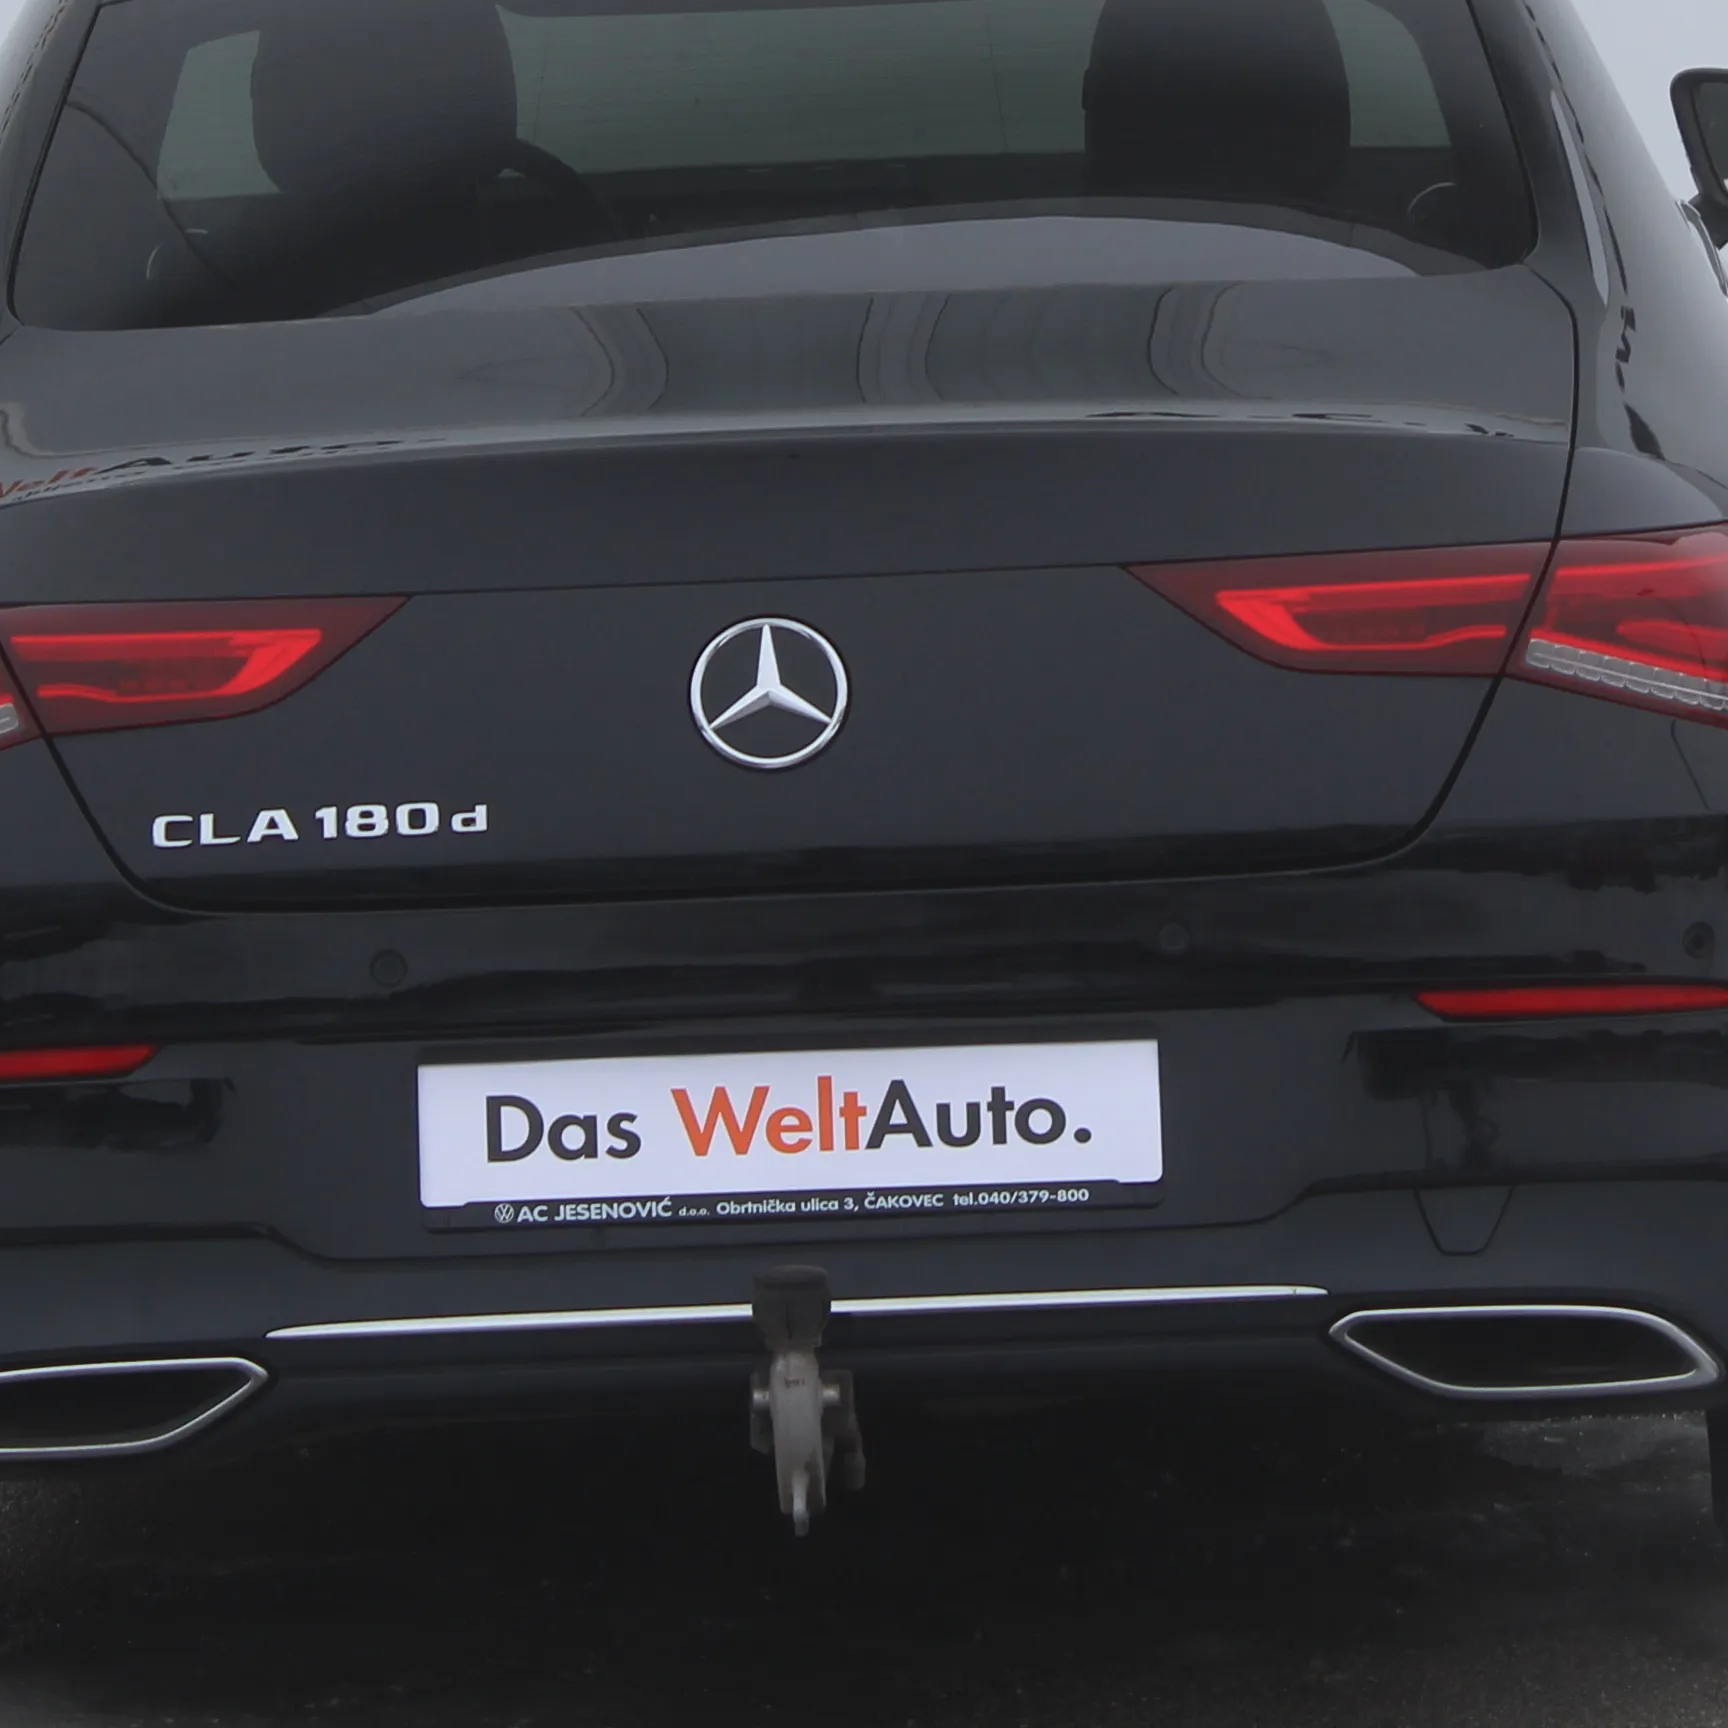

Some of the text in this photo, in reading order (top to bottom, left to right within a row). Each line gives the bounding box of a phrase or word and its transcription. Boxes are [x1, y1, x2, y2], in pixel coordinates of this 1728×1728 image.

[152, 809, 299, 848] CLA
[485, 1075, 1092, 1164] Das WeltAuto.
[516, 1205, 549, 1224] AC
[554, 1196, 674, 1223] JESENOVIĆ
[678, 1205, 711, 1218] d.o.o.
[715, 1197, 797, 1216] Obrtnička
[800, 1196, 840, 1214] ulica
[843, 1196, 860, 1214] 3,
[863, 1190, 945, 1211] ČAKOVEC
